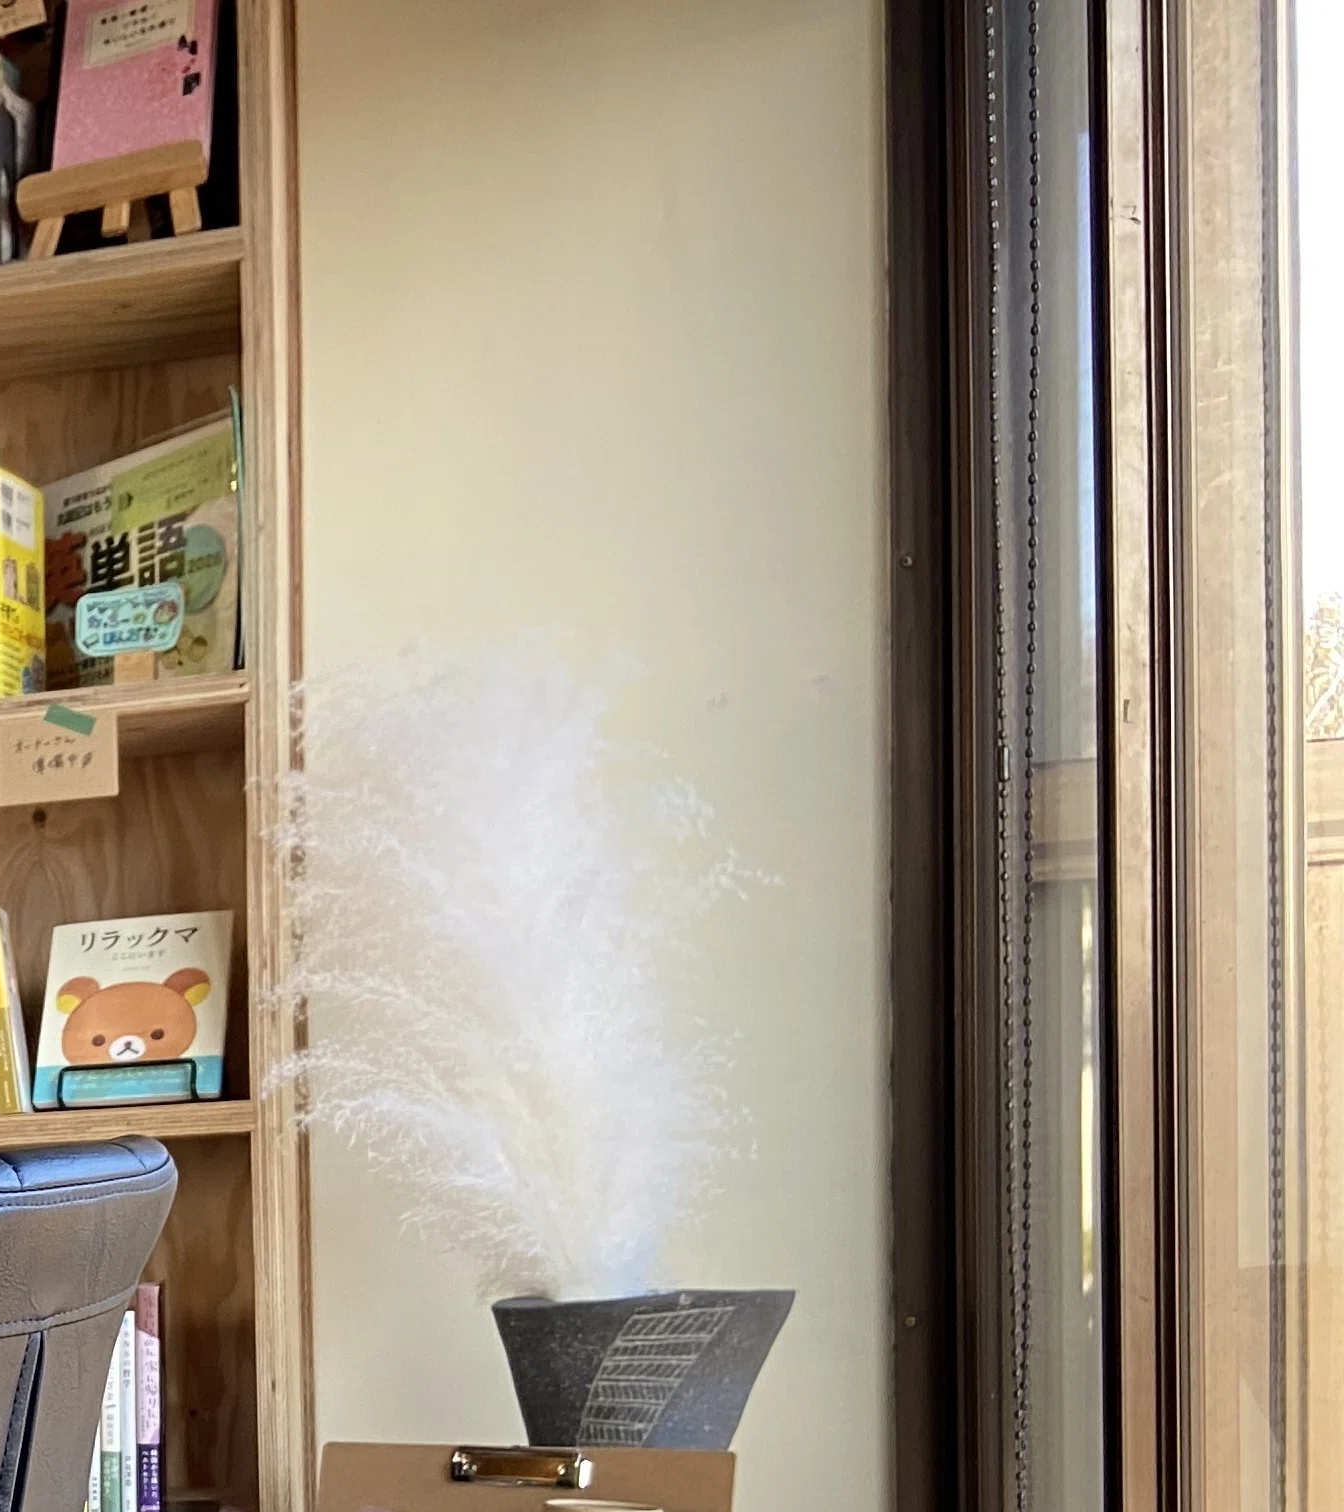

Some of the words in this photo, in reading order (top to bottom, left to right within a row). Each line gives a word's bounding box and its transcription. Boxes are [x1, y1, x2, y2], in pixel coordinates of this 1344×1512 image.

[80, 925, 201, 953] リラックマ
